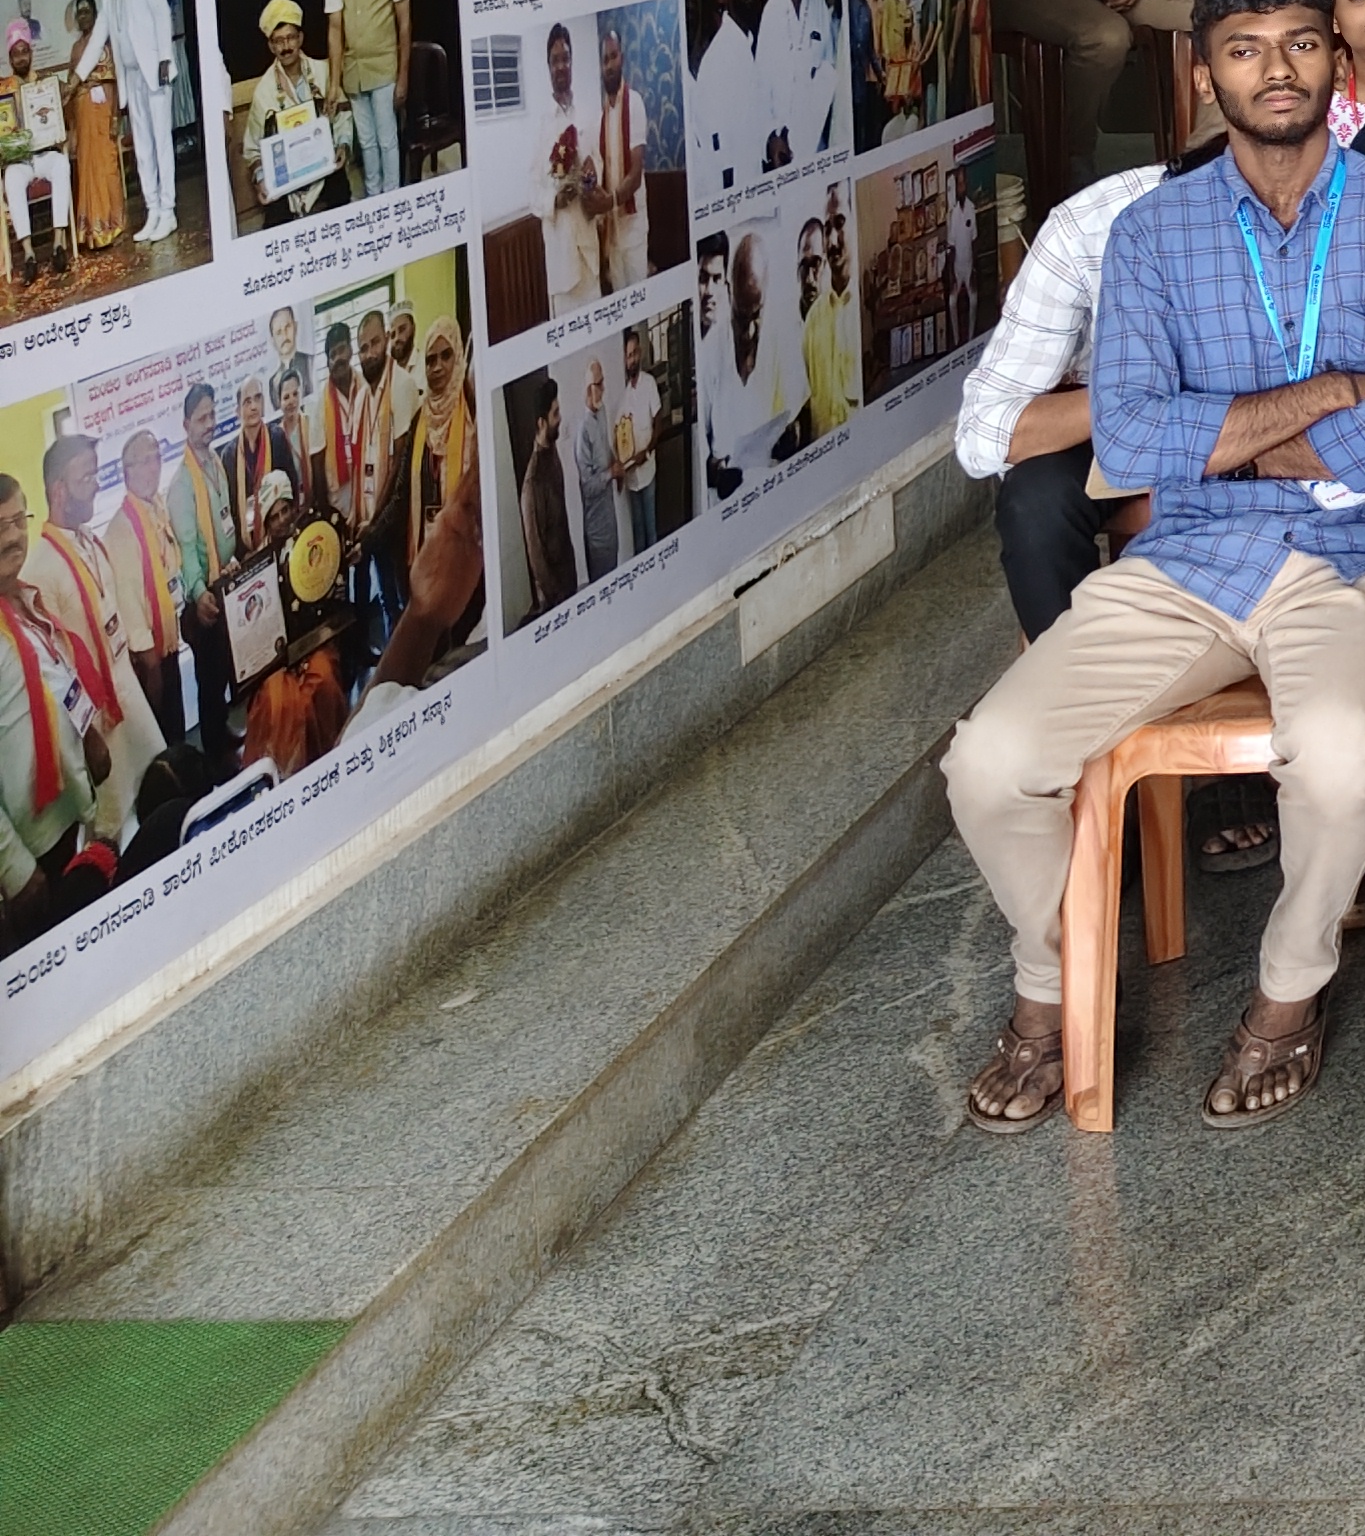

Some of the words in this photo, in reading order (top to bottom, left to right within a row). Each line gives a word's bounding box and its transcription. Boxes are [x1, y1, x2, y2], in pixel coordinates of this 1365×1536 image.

[264, 237, 290, 263] ದಕ್ಷಿಣ
[294, 229, 317, 254] ಕನ್ನಡ
[341, 246, 352, 270] ಶ್ರೀ
[443, 208, 467, 233] ಸನ್ಮಾನ
[24, 313, 93, 351] ಅಂಬೇಡ್ಕರ್
[100, 303, 132, 333] ಪ್ರಶಸ್ತಿ
[6, 945, 67, 999] ಮಂಚಿಲ
[75, 888, 155, 952] ಅಂಗನವಾಡಿ
[162, 852, 203, 897] ಶಾಲೆಗೆ
[209, 797, 295, 866] ಪೀಠೋಪಕರಣ
[300, 762, 340, 805] ವಿತರಣೆ
[345, 743, 374, 775] ಮತ್ತು
[378, 711, 418, 756] ಶಿಕ್ಷಕರಿಗೆ
[421, 690, 452, 726] ಸನ್ಮಾನ
